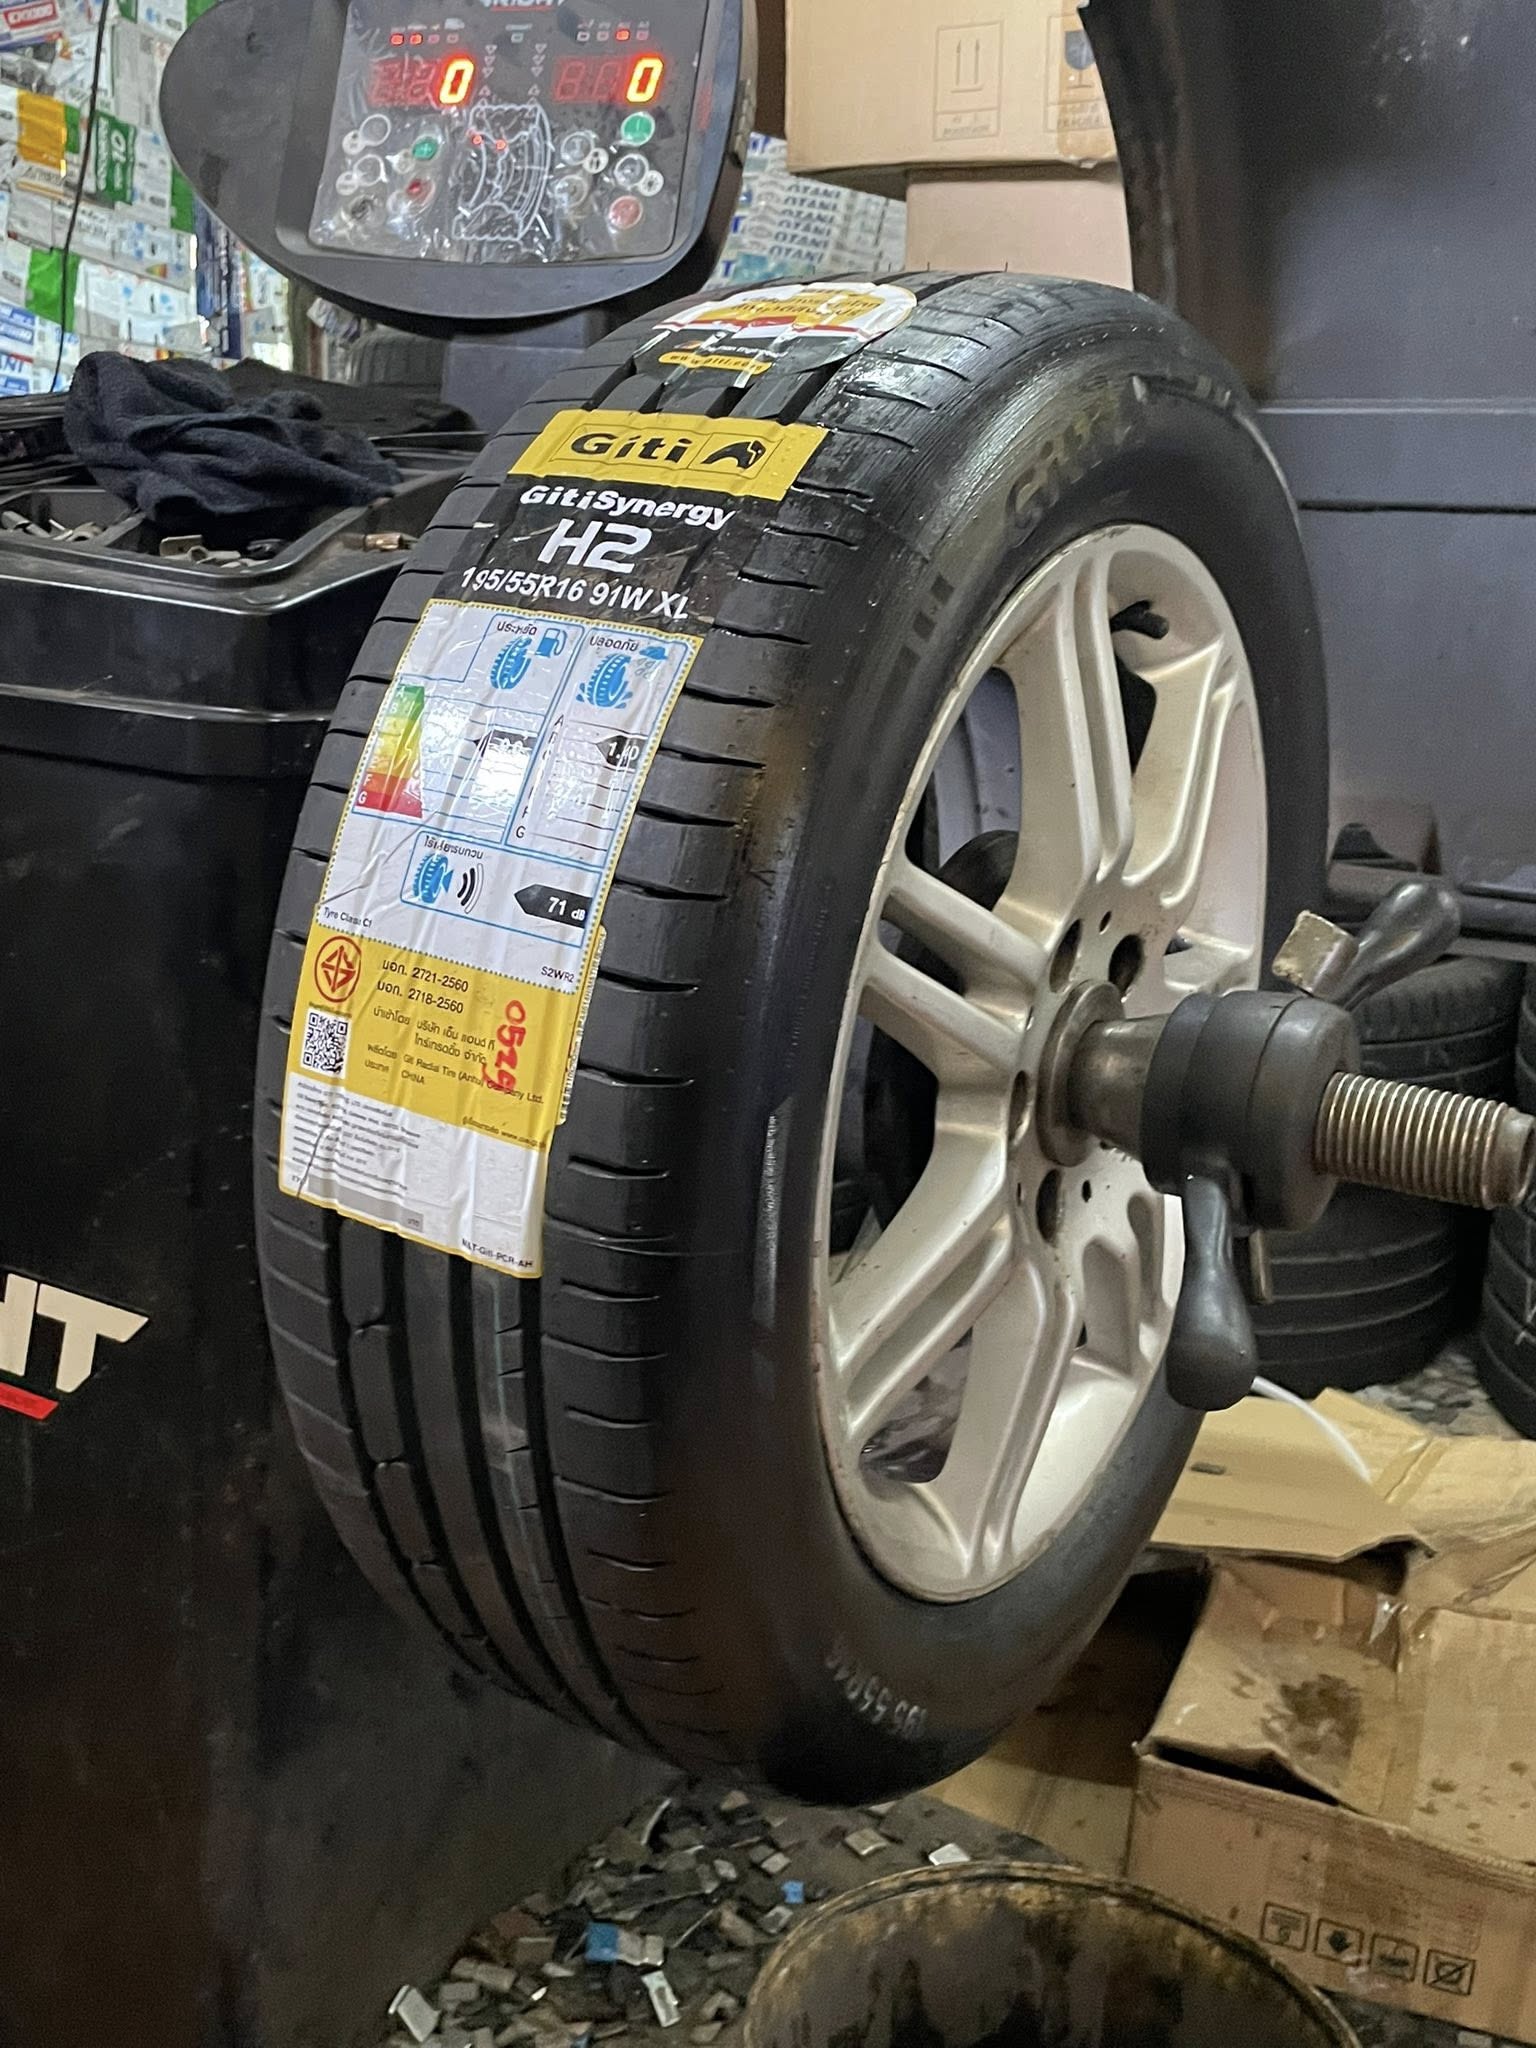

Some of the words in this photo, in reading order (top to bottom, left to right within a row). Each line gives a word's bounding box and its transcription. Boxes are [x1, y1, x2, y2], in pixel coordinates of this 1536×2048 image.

[439, 58, 474, 104] 0
[627, 58, 664, 103] 0
[570, 434, 692, 465] Giti
[520, 485, 736, 531] GitiSynergy
[537, 518, 654, 574] H2
[460, 568, 585, 604] 195/55R16
[591, 583, 653, 612] 91W
[650, 589, 690, 620] XL
[496, 621, 538, 636] ประหยัด
[589, 635, 640, 652] ปลอดภัย
[358, 791, 368, 804] G
[516, 826, 526, 838] G
[323, 907, 339, 919] Tyre
[547, 896, 567, 916] 71
[571, 909, 587, 921] dB
[382, 959, 407, 976] มอก.
[412, 967, 469, 993] 2721-2560
[541, 966, 575, 983] S2WR2
[377, 980, 403, 997] มอก.
[408, 988, 464, 1014] 2718-2560
[401, 1070, 425, 1085] CHINA
